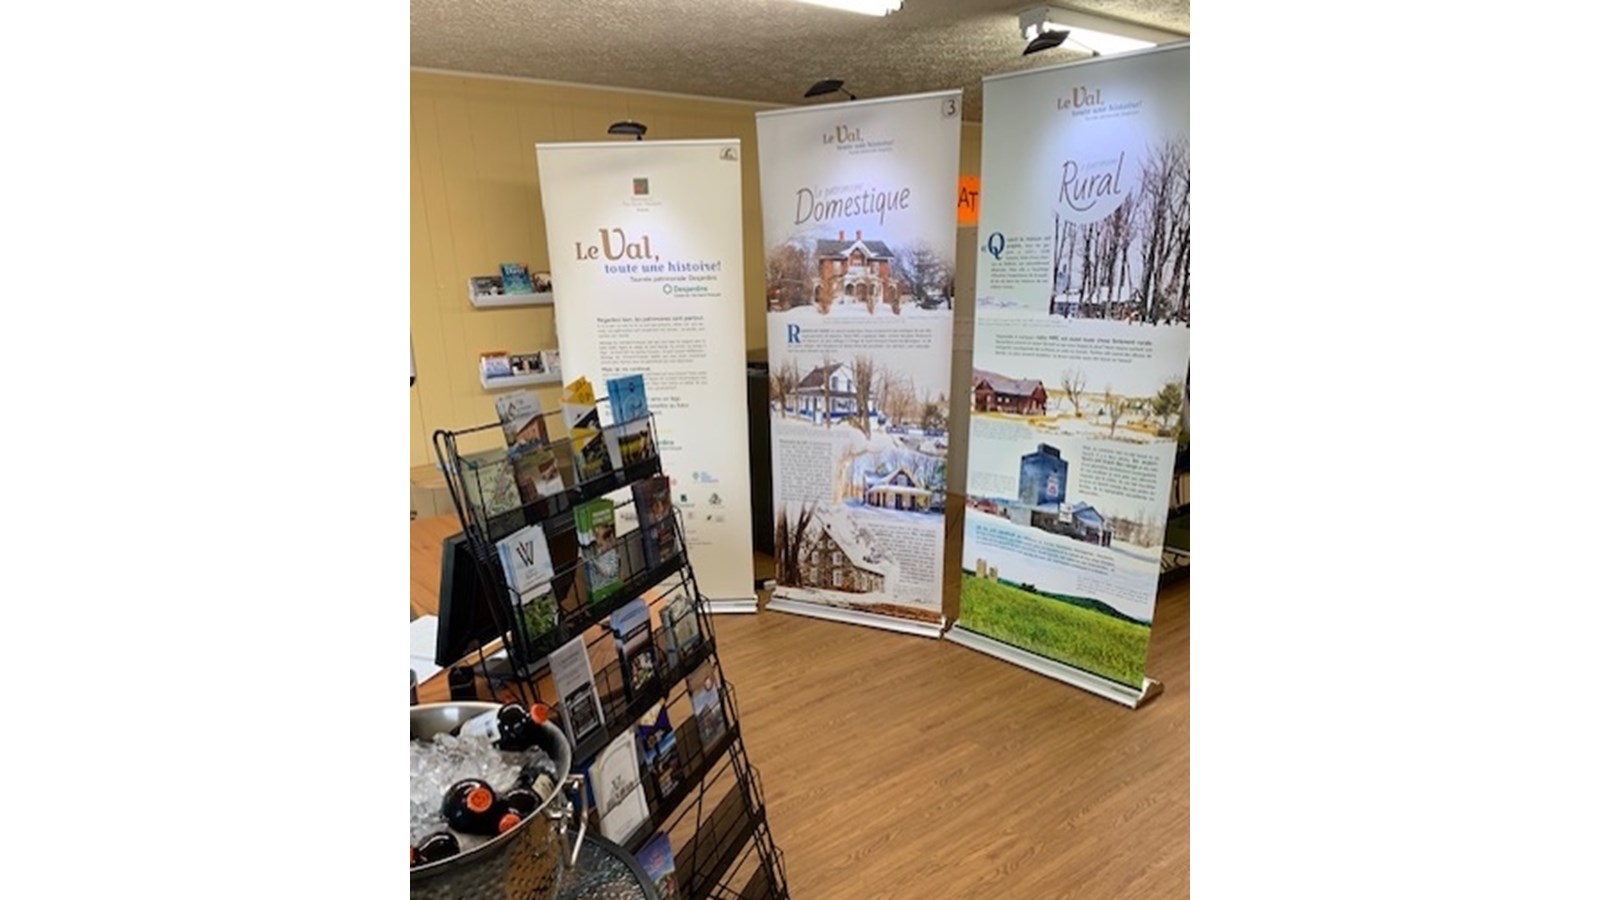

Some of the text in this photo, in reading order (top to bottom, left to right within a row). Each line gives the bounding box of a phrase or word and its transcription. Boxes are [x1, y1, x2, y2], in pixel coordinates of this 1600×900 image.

[947, 99, 956, 116] 3
[1059, 151, 1125, 212] Rural
[794, 187, 911, 226] Domestique
[575, 241, 599, 260] Le
[604, 260, 721, 274] toute une histoire!
